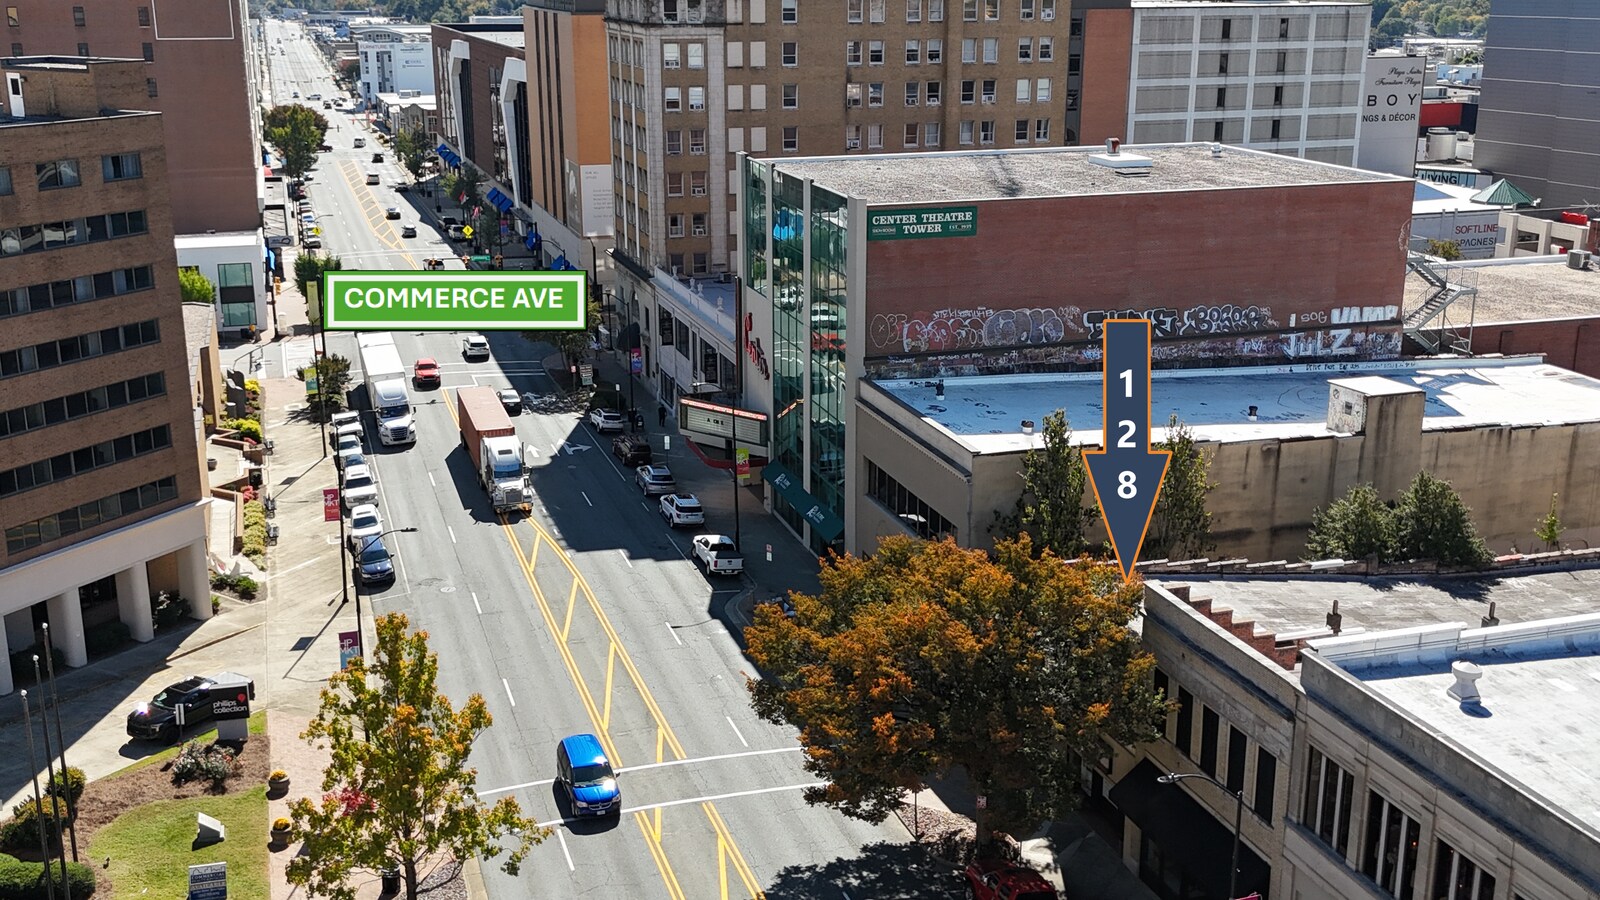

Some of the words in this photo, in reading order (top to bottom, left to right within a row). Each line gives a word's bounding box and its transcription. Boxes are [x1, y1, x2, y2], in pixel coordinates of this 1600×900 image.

[872, 214, 917, 225] CENTER
[921, 211, 972, 223] THEATRE
[903, 223, 942, 234] TOWER
[213, 700, 237, 709] phillips
[214, 706, 247, 714] collection
